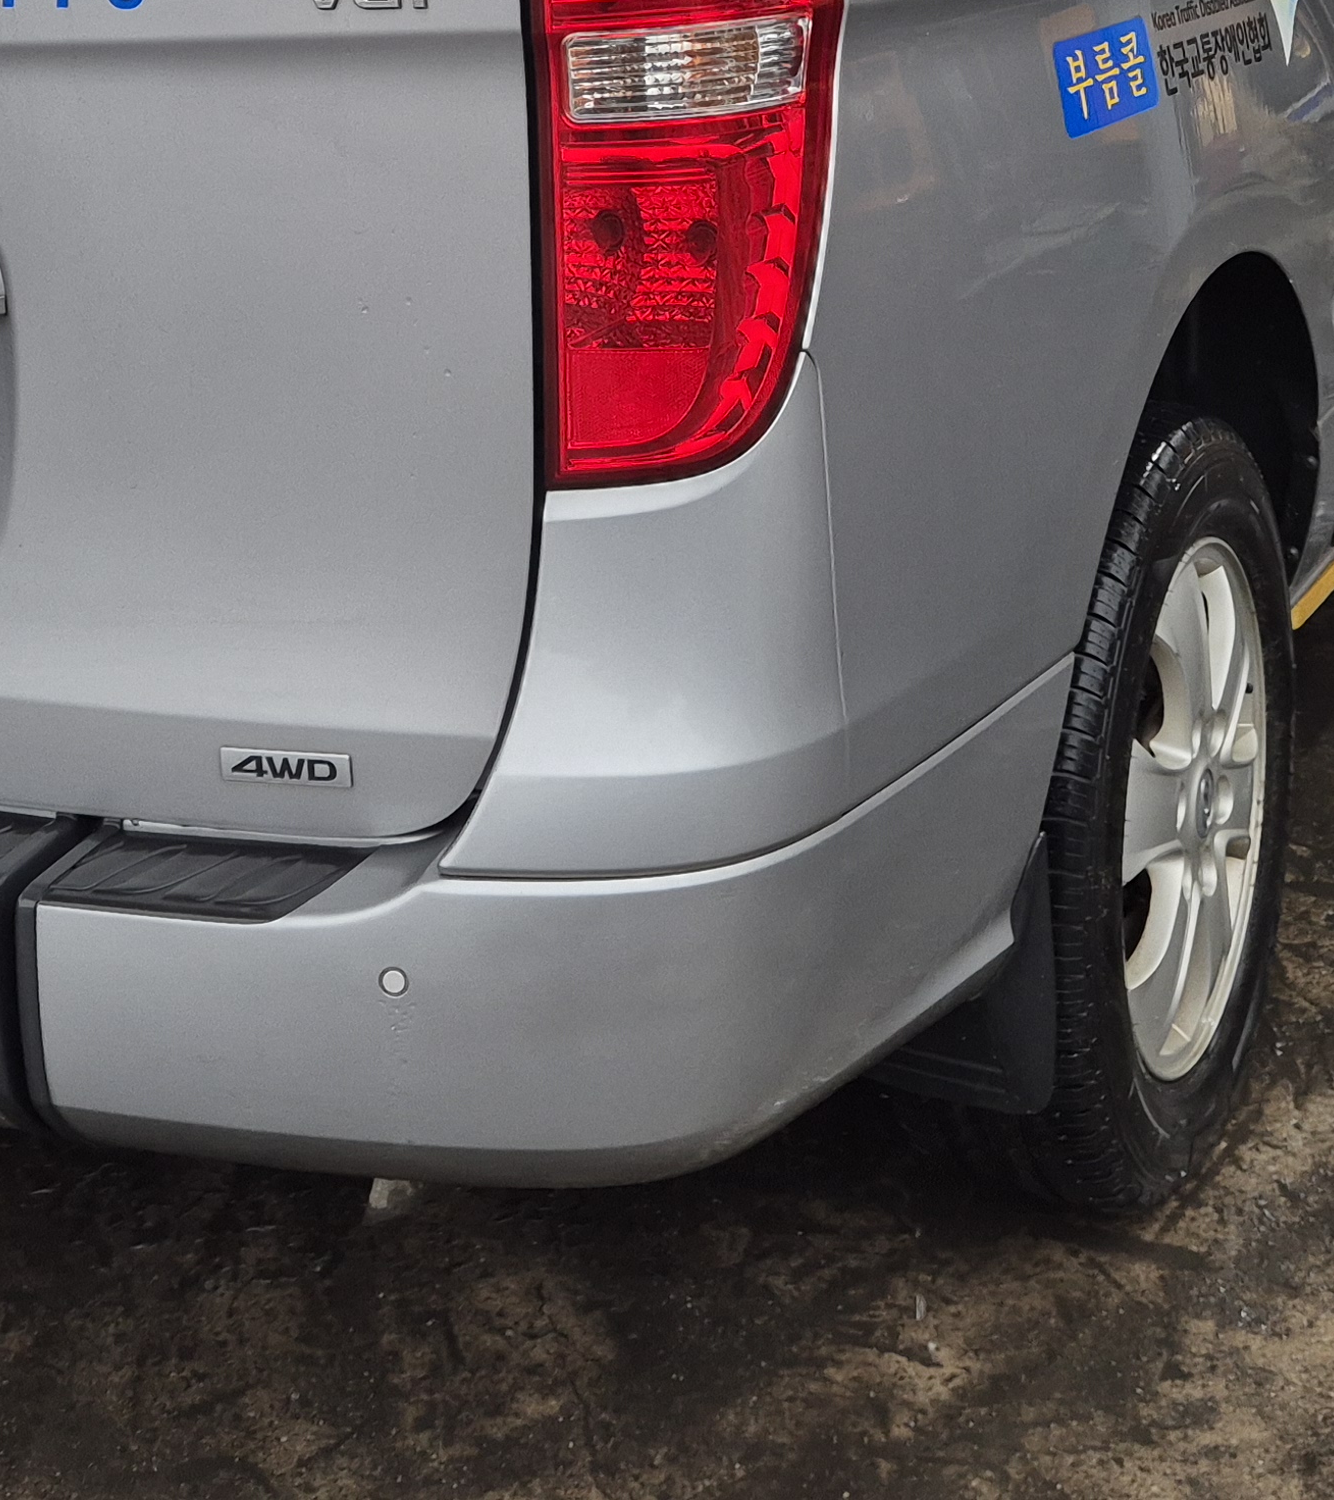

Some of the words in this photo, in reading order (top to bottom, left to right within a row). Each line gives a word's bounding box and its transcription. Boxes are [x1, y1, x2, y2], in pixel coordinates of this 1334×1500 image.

[1151, 10, 1176, 32] Korea
[1174, 0, 1201, 25] Traffic
[1065, 30, 1149, 121] 부름콜
[1157, 11, 1273, 97] 한국교통장애인협회
[230, 755, 338, 782] 4WD
